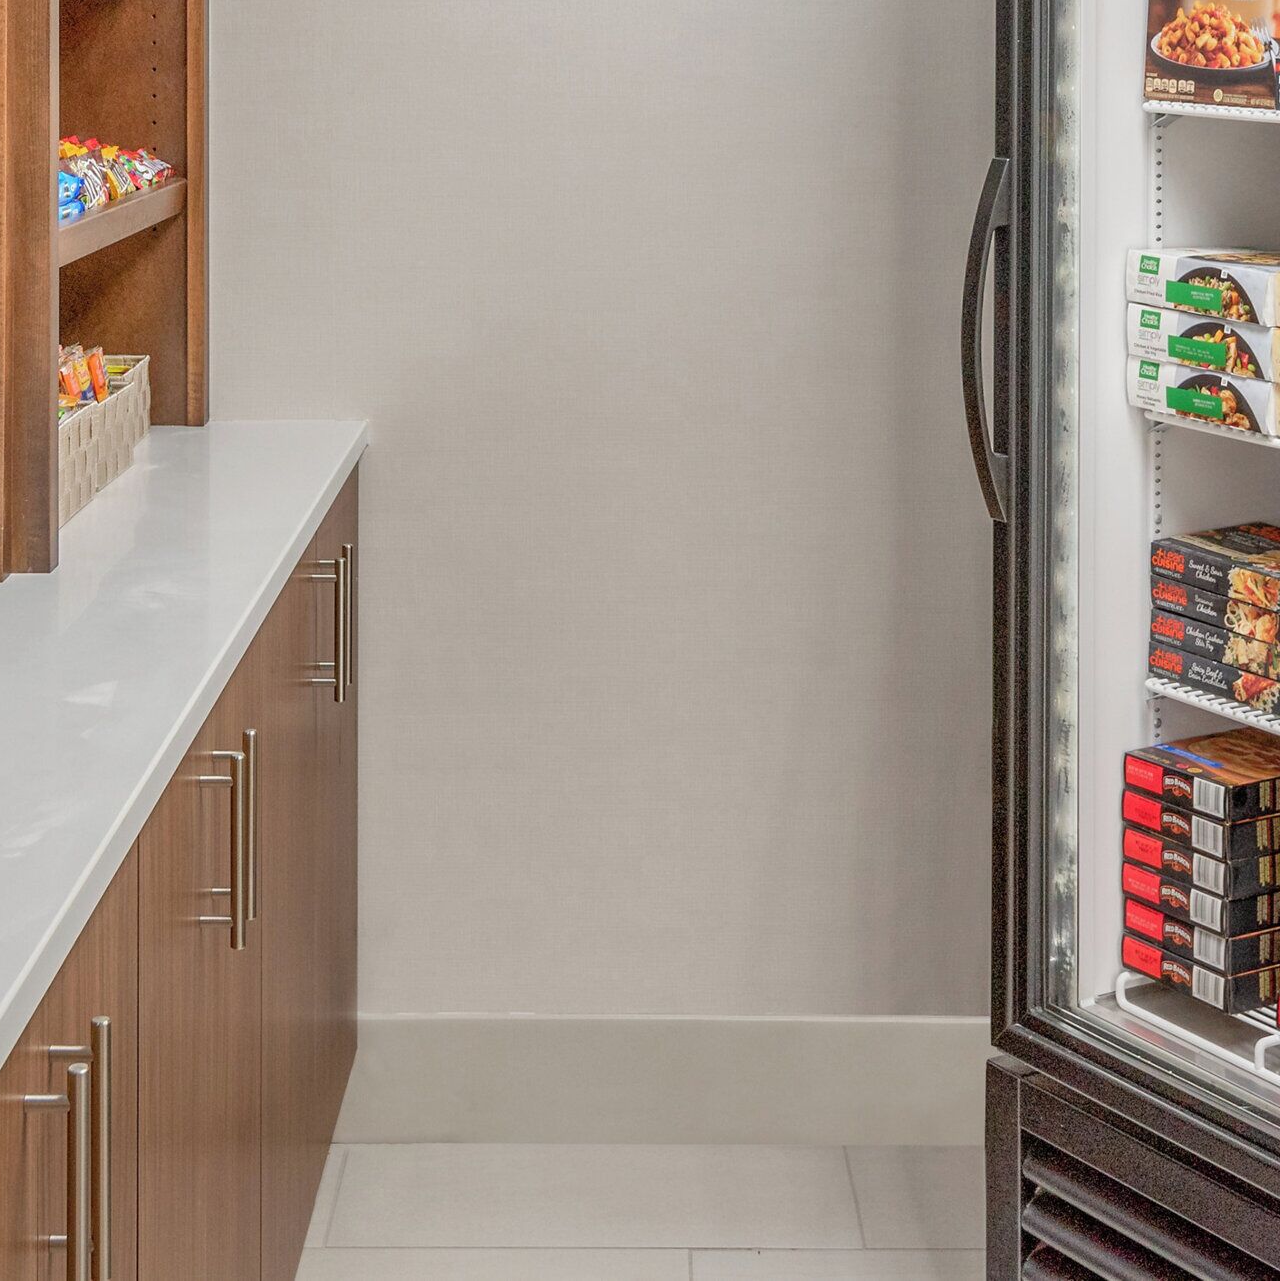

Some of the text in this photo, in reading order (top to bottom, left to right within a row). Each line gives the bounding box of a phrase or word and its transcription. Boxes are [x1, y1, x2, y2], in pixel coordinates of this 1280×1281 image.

[1195, 571, 1216, 584] Chicken
[1196, 605, 1217, 617] Chicken
[1164, 777, 1191, 792] RED BARON
[1163, 814, 1190, 830] RED BARON
[1163, 852, 1190, 867] RED BARON
[1161, 887, 1188, 906] RED BARON
[1164, 924, 1192, 943] RED BARON
[1163, 962, 1190, 981] RED BARON
